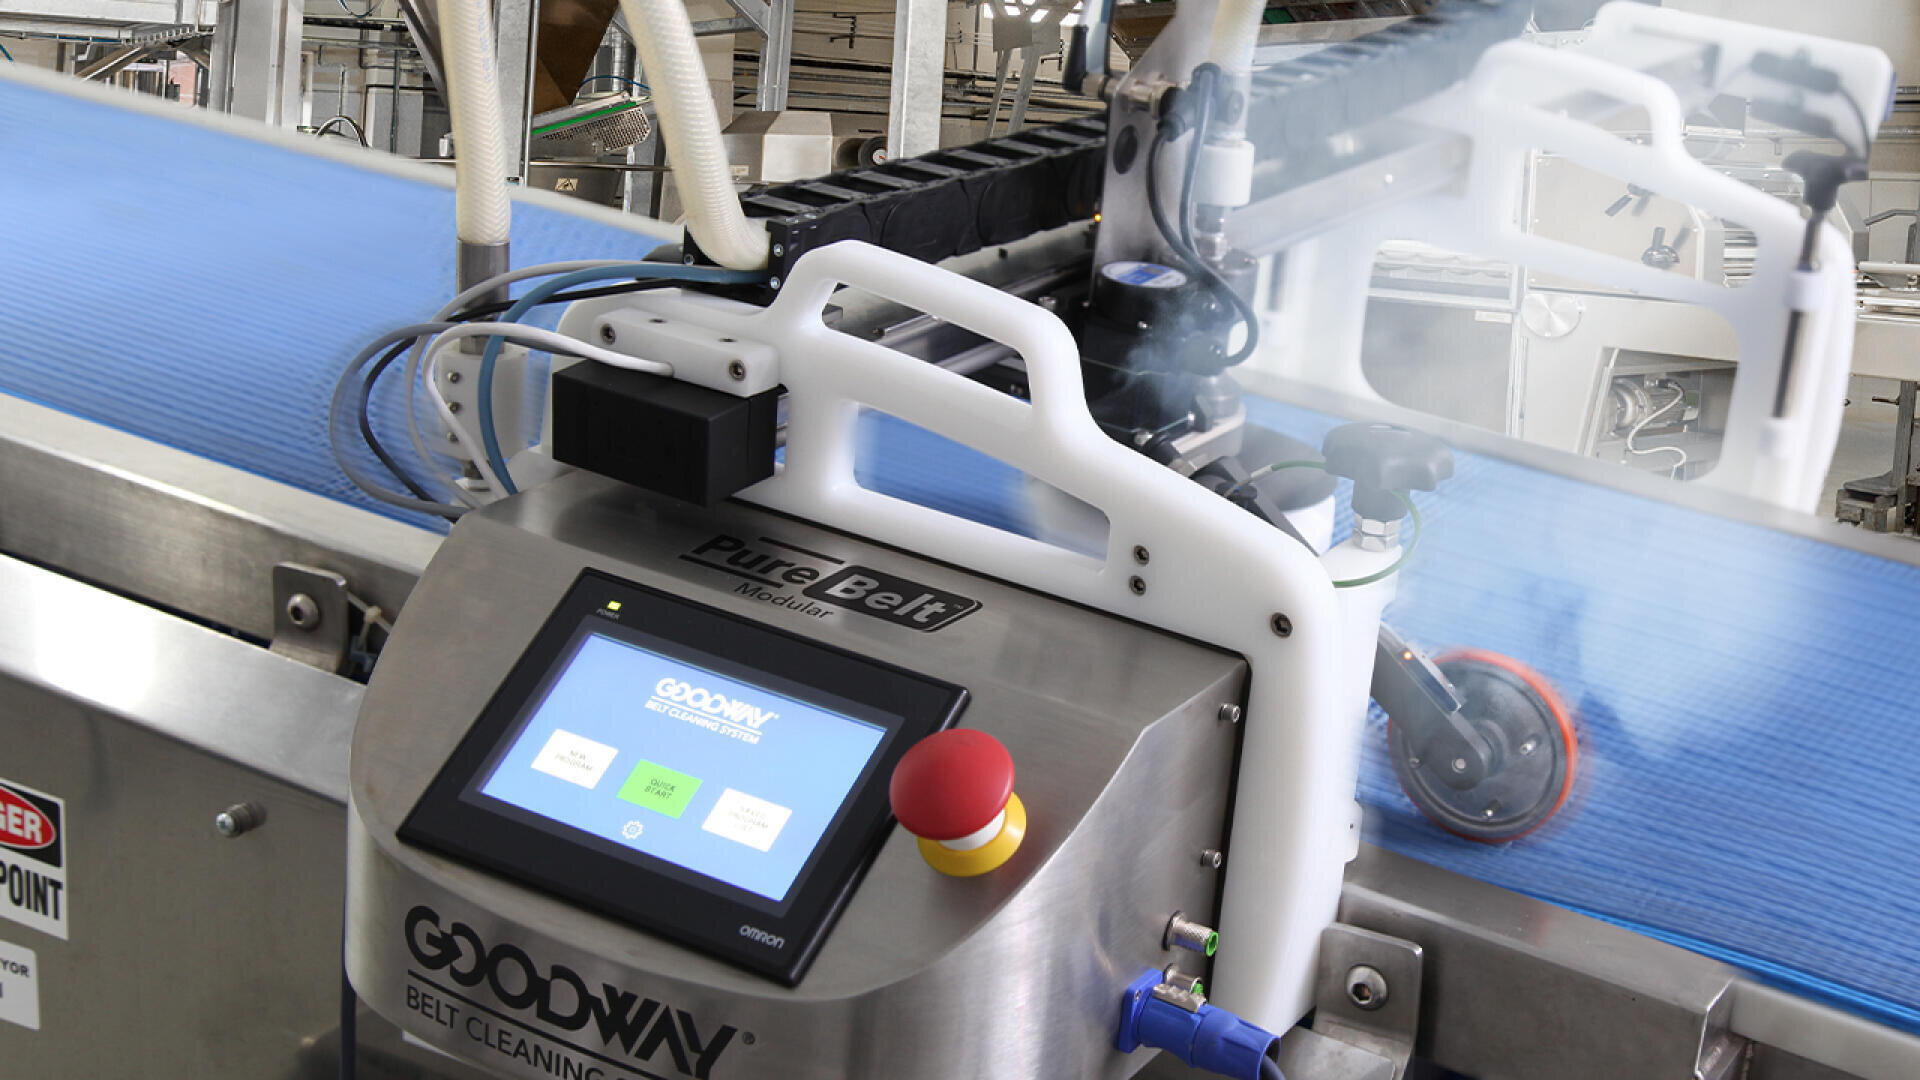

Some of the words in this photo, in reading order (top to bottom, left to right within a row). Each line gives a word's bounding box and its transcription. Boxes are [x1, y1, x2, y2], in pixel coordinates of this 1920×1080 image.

[691, 534, 820, 585] Pure
[824, 574, 947, 623] Belt
[734, 582, 834, 619] Modular
[645, 699, 670, 713] BELT
[668, 707, 720, 732] CLEANING
[719, 725, 760, 745] SYSTEM
[656, 677, 775, 729] GOODWAY
[644, 785, 672, 799] START
[650, 779, 676, 793] QUICK
[404, 905, 738, 1080] GOODWAY
[406, 984, 460, 1030] BELT
